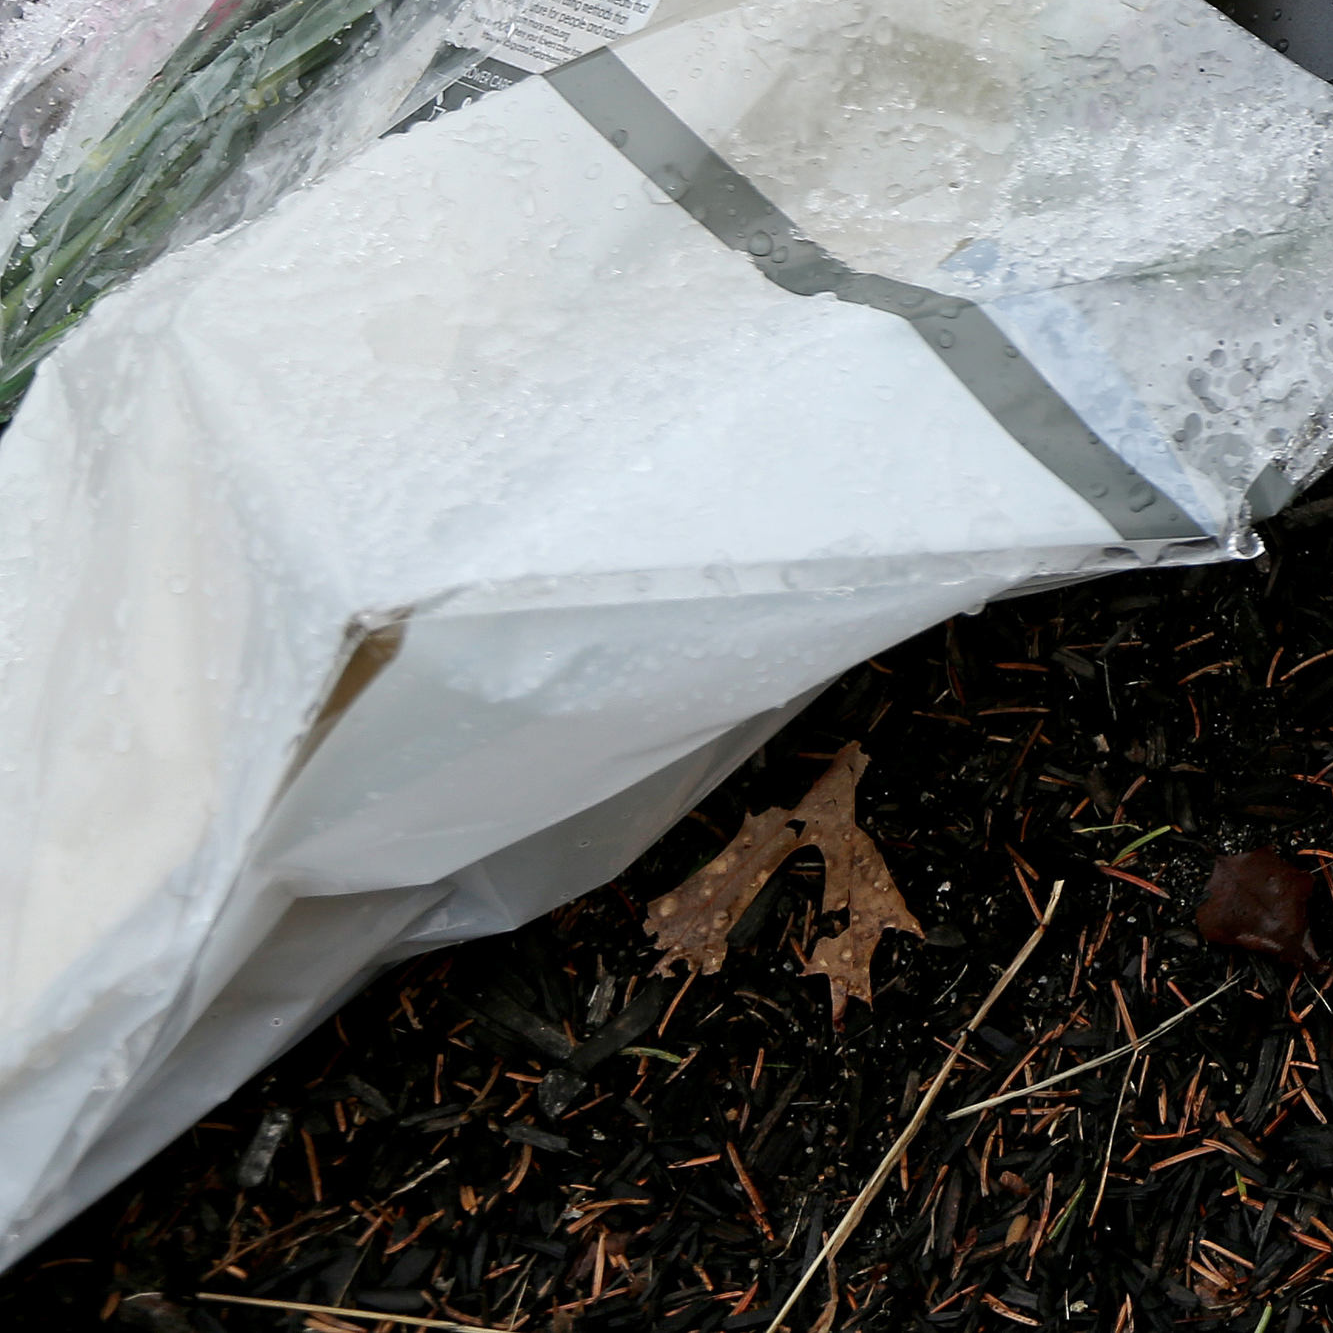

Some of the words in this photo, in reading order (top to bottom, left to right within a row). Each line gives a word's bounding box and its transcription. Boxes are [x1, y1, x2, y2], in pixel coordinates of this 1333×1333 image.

[548, 6, 558, 19] for
[558, 13, 586, 29] people
[586, 23, 602, 35] and
[582, 3, 612, 20] methods
